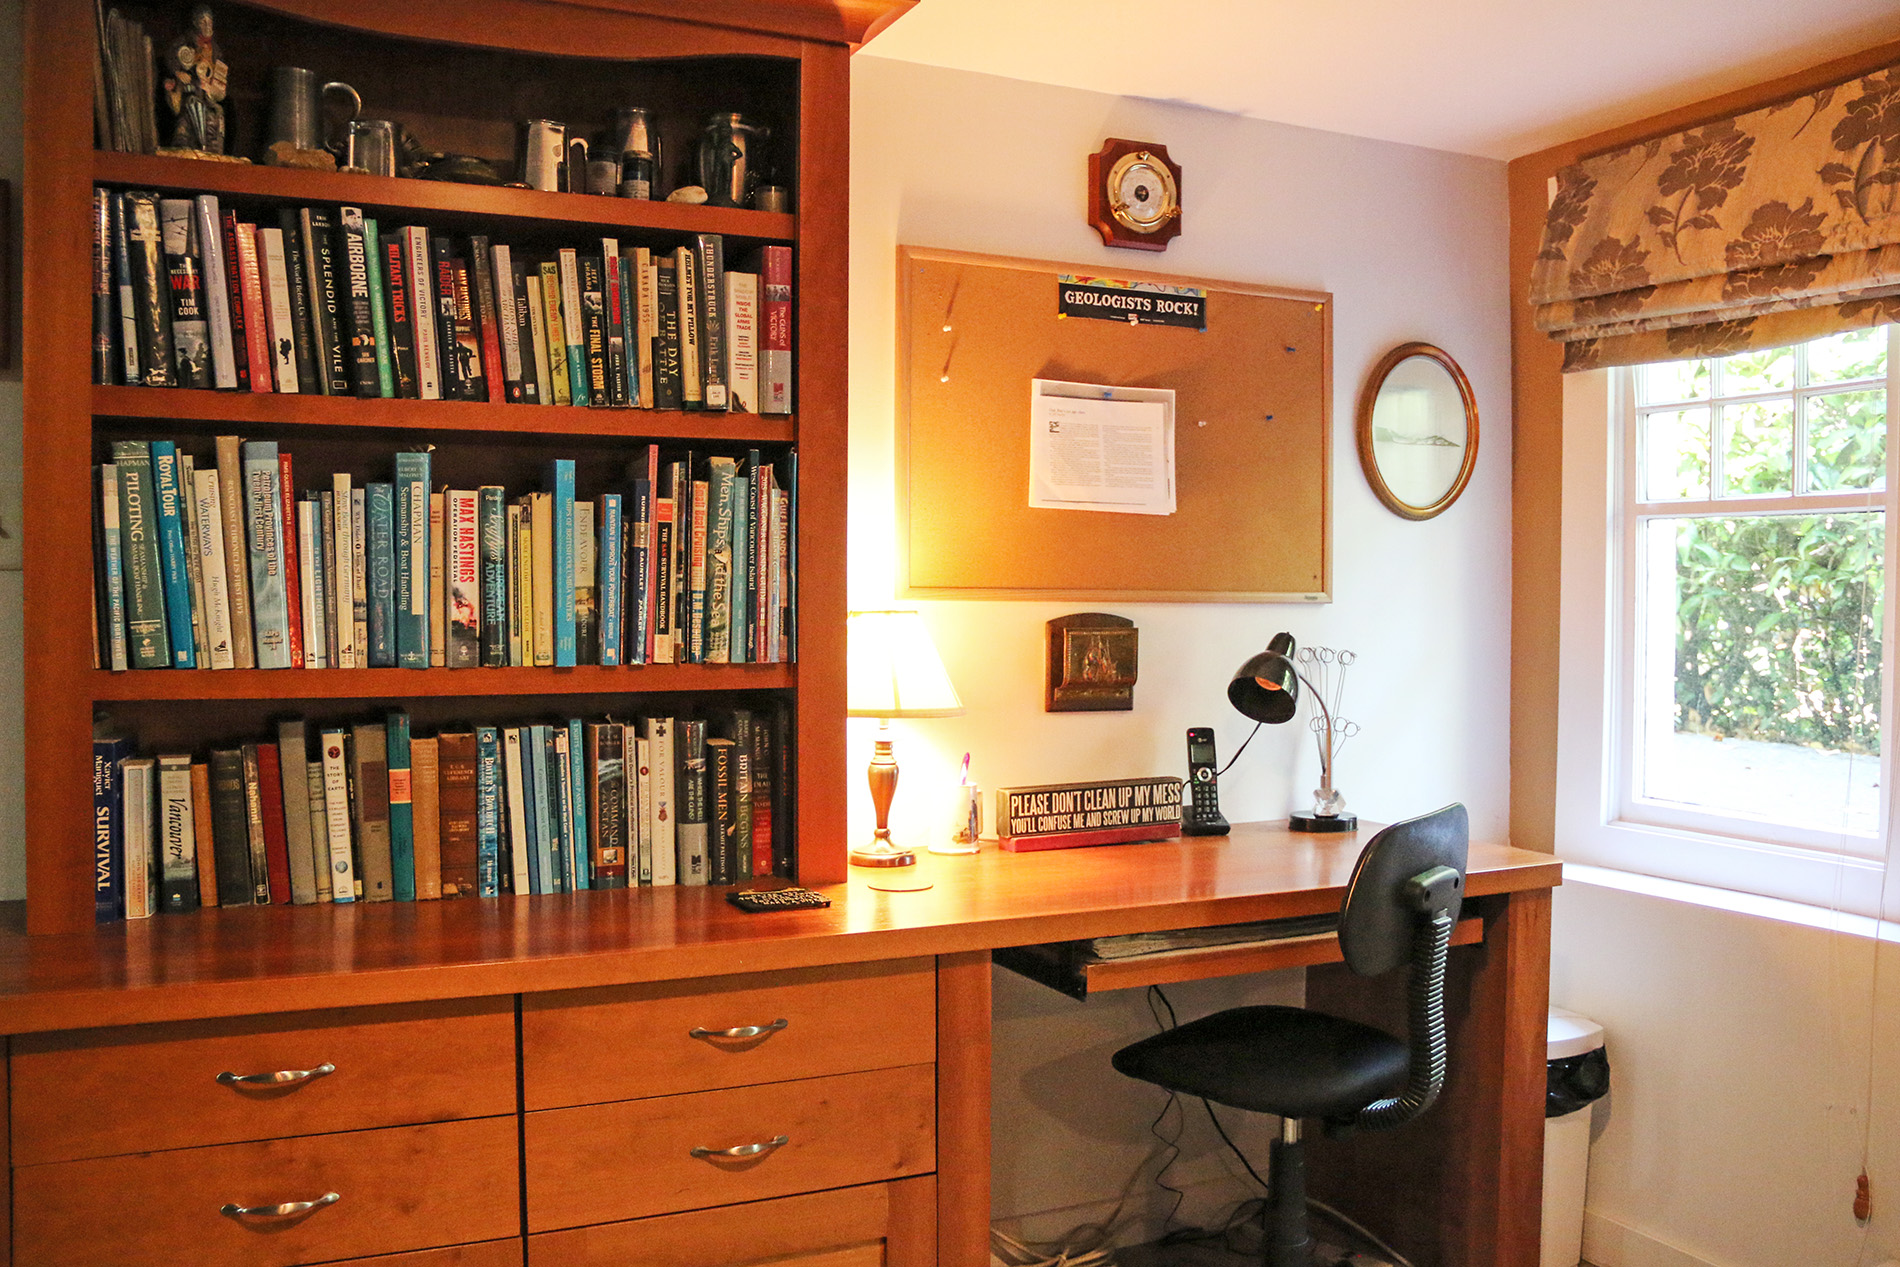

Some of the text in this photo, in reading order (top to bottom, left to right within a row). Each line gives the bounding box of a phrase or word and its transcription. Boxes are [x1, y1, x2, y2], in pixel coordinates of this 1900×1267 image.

[170, 274, 200, 291] WAR
[227, 232, 243, 330] ASSASSINATION COMPLEX
[347, 232, 368, 298] AIRBORNE
[387, 243, 406, 323] MILITANT TRICKS
[414, 236, 428, 319] ENGINEERS OF VICTORY
[438, 261, 452, 295] RAIDER
[542, 265, 556, 275] SAS
[584, 261, 592, 291] SHAARA
[590, 268, 598, 284] JEFF
[684, 254, 693, 286] HELMET
[705, 242, 717, 318] THUNDERSTRUCK
[180, 298, 195, 307] TIM
[609, 255, 622, 324] SECRET COMMANDOS
[641, 262, 651, 323] CANADA 1955
[687, 303, 694, 315] MY
[1064, 290, 1199, 316] GEOLOGISTS ROCK!
[178, 306, 200, 316] COOK
[321, 248, 344, 373] SPLENDID VILE
[516, 295, 527, 326] Taliban
[549, 300, 560, 343] ENEMY LINES
[769, 310, 778, 341] VICTORY
[779, 306, 787, 318] The
[779, 318, 787, 339] GUNS
[589, 328, 602, 354] FINAL
[666, 310, 679, 377] THE DAY
[687, 316, 695, 346] PILLOW
[592, 357, 605, 390] STORM
[157, 455, 177, 517] ROYAL TOUR
[207, 474, 218, 508] Cruising
[284, 492, 292, 519] ELIZABETH
[125, 472, 144, 542] PILOTING
[262, 470, 277, 576] Petroleum Provinces of the
[324, 509, 332, 533] Geology
[399, 486, 410, 537] Seamanship
[412, 486, 423, 545] CHAPMAN
[565, 517, 572, 526] OF
[693, 484, 705, 568] Small Boat Cruising
[779, 497, 788, 518] GULF
[199, 497, 213, 557] WATERWAYS
[254, 519, 265, 551] Century
[371, 492, 392, 599] WATER ROAD
[459, 497, 475, 583] MAX HASTINGS
[579, 507, 591, 574] ENDEAVOUR
[748, 522, 756, 564] Vancouver
[110, 547, 120, 575] WEATHER
[227, 480, 243, 616] RAINCOAST CHRONICLES FIRST FIVE
[340, 490, 351, 604] Slow Boat through Germany
[400, 550, 410, 570] Boat
[711, 472, 734, 627] Men, the Sea
[759, 494, 767, 603] WAGGONER GUIDE
[210, 575, 220, 596] Hugh
[399, 572, 410, 611] Handling
[486, 561, 496, 625] ADVENTURE
[495, 564, 505, 622] EUROPEAN
[565, 557, 573, 593] COLUMBIA
[660, 557, 668, 590] SURVIVAL
[748, 566, 756, 590] Island
[113, 598, 121, 622] PACIFIC
[314, 569, 323, 628] LIGHTHOUSE
[565, 594, 573, 622] WATERS
[659, 591, 667, 630] HANDBOOK
[114, 623, 122, 660] NORTHWEST
[93, 755, 105, 796] Maniguet
[104, 761, 114, 790] Xavier
[717, 748, 728, 821] FOSSIL MEN
[248, 781, 260, 824] Nahanni
[601, 801, 609, 838] OCEAN
[610, 789, 619, 845] COMMAND
[739, 754, 750, 848] BRITAIN BEGINS
[1010, 805, 1181, 834] YOU'LL CONFUSE ME AND SCREW UP MY WORLD
[1011, 793, 1050, 817] PLEASE
[1051, 790, 1082, 813] DON'T
[1084, 788, 1116, 811] CLEAN
[1118, 787, 1132, 808] UP
[1134, 786, 1151, 806] MY
[1152, 783, 1181, 805] MESS
[168, 797, 188, 860] Vancouver
[96, 806, 111, 891] SURVIVAL
